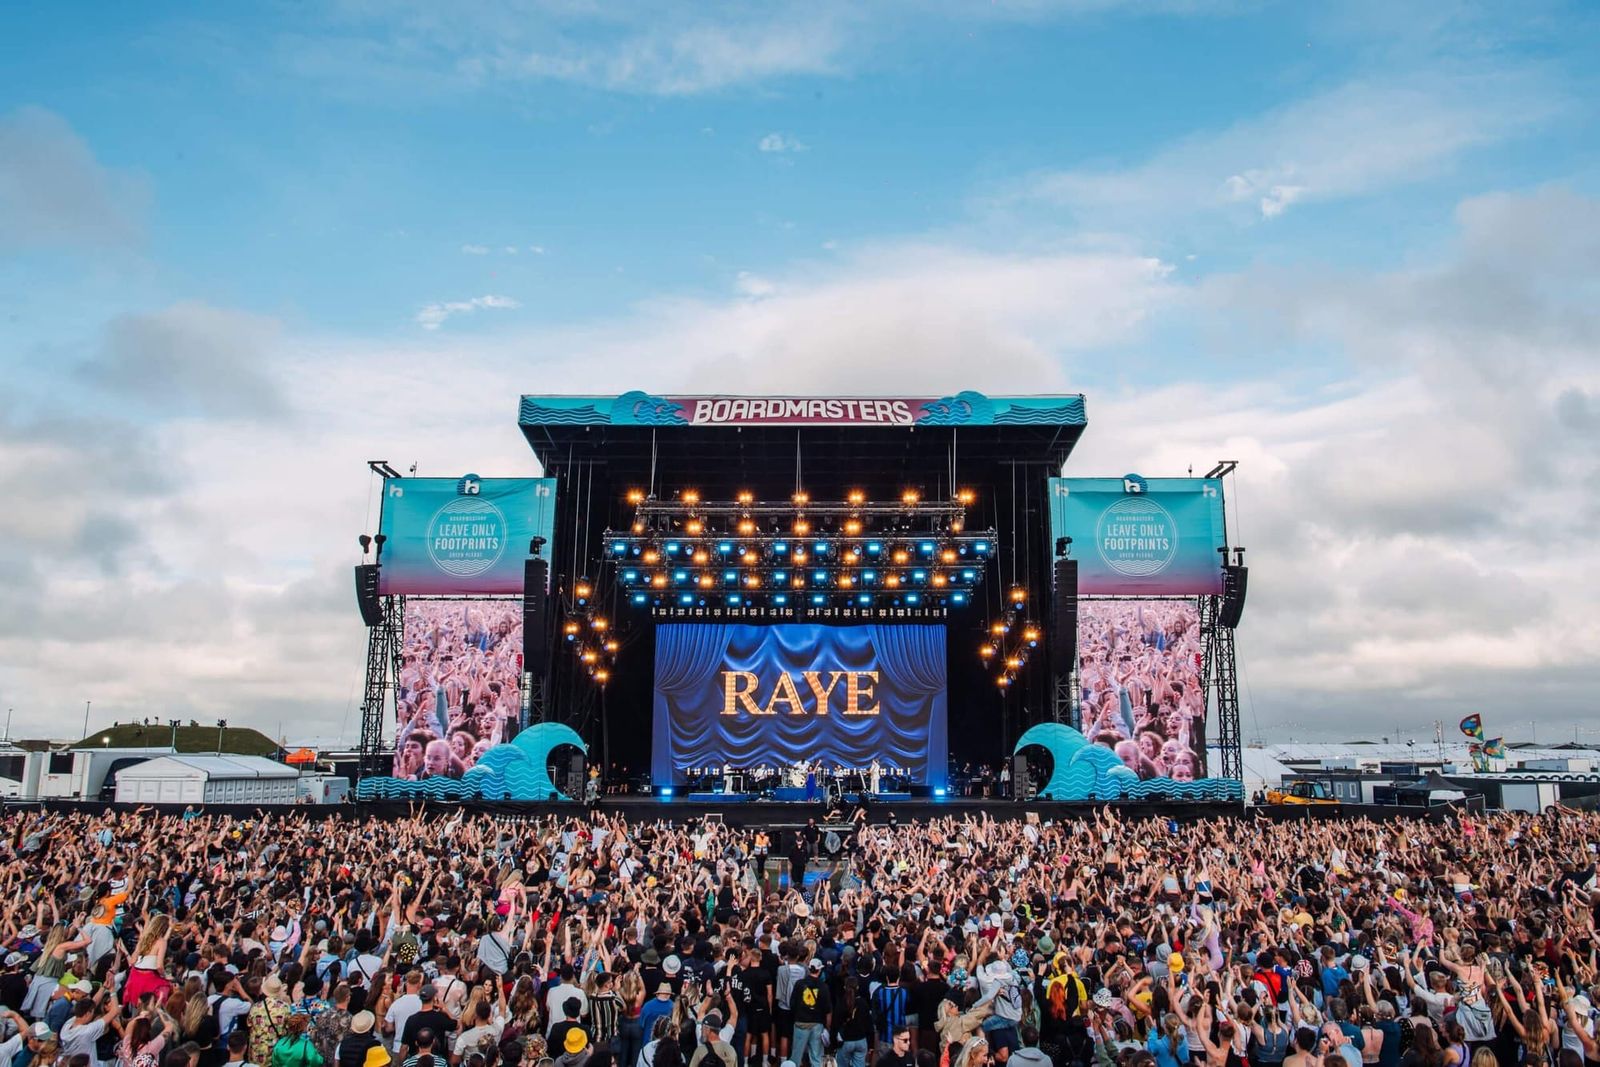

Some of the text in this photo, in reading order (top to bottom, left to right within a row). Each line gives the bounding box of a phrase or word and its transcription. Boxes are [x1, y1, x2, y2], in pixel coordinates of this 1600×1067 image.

[692, 400, 913, 423] BOARDMASTERS
[439, 524, 496, 536] LEAVE ONLY
[1107, 524, 1164, 537] LEAVE ONLY
[435, 537, 499, 550] FOOTPRINTS
[1104, 538, 1169, 550] FOOTPRINTS
[720, 671, 880, 715] RAYE
